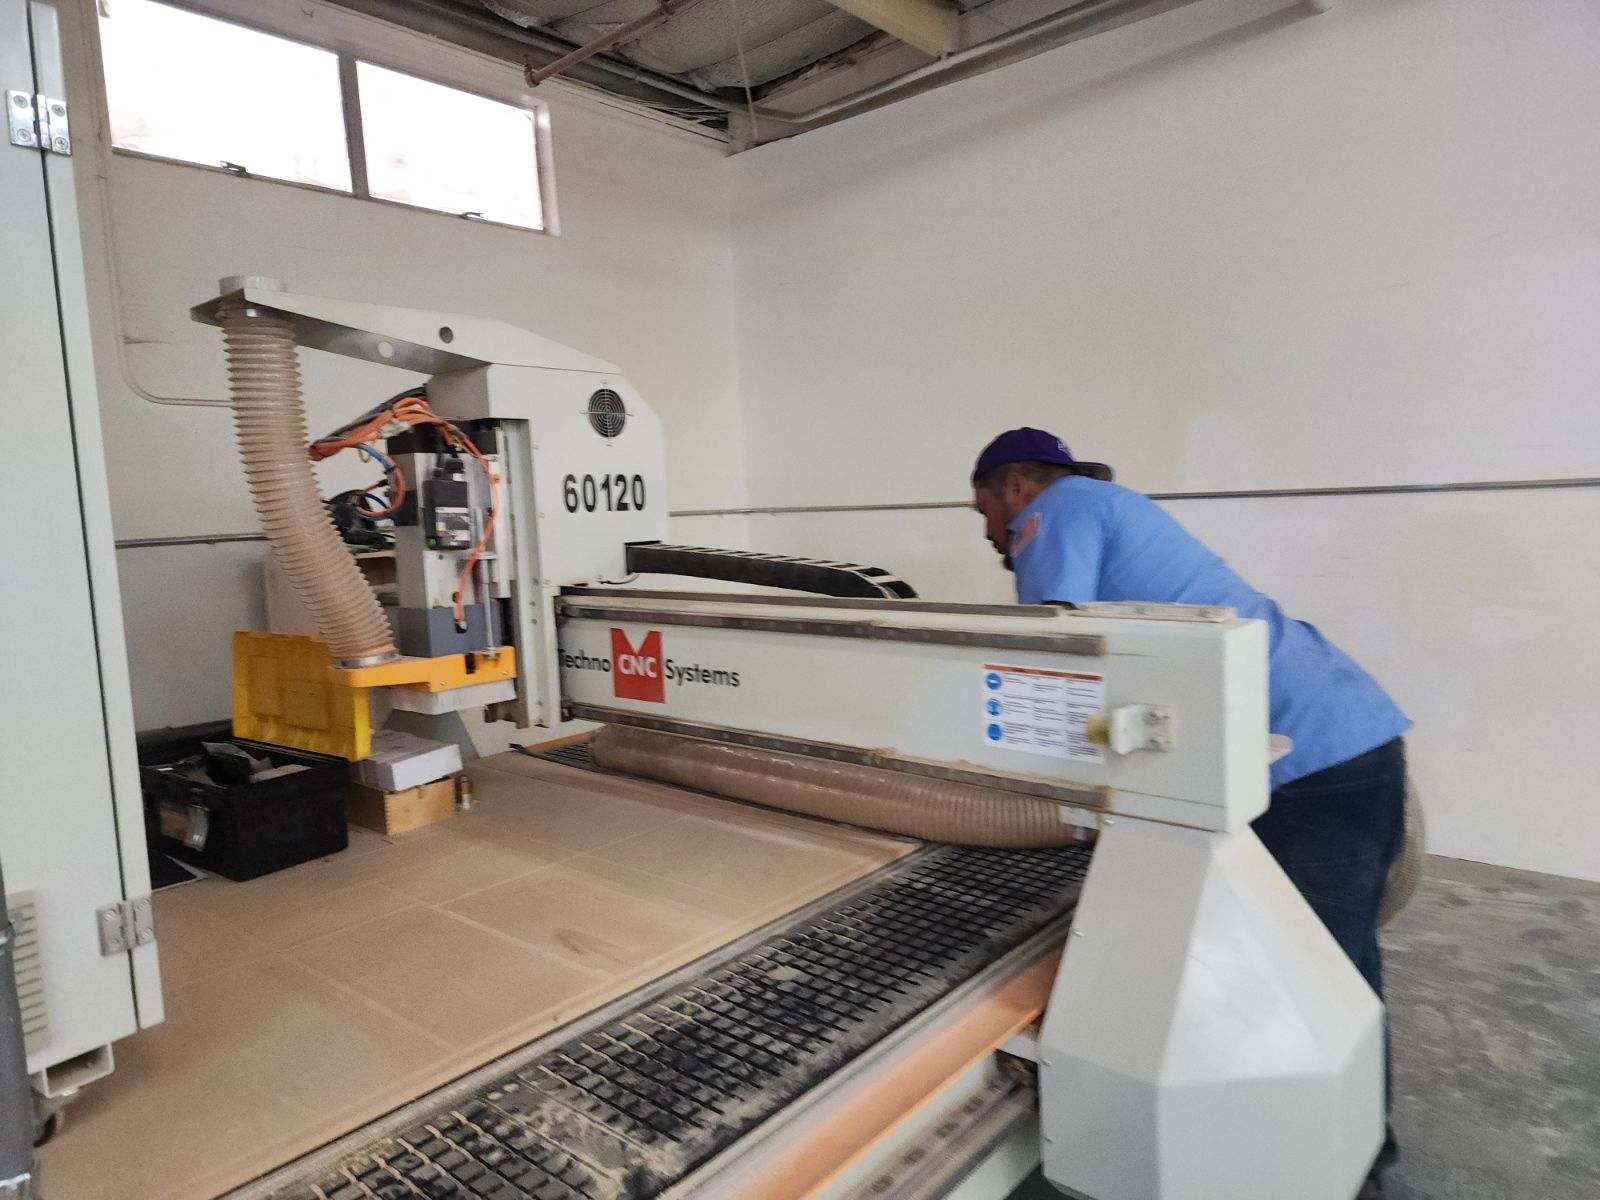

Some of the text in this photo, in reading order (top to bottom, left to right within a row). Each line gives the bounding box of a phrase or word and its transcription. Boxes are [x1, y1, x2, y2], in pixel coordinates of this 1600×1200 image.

[564, 474, 645, 513] 60120
[619, 654, 657, 678] CNC
[665, 659, 741, 687] Systems
